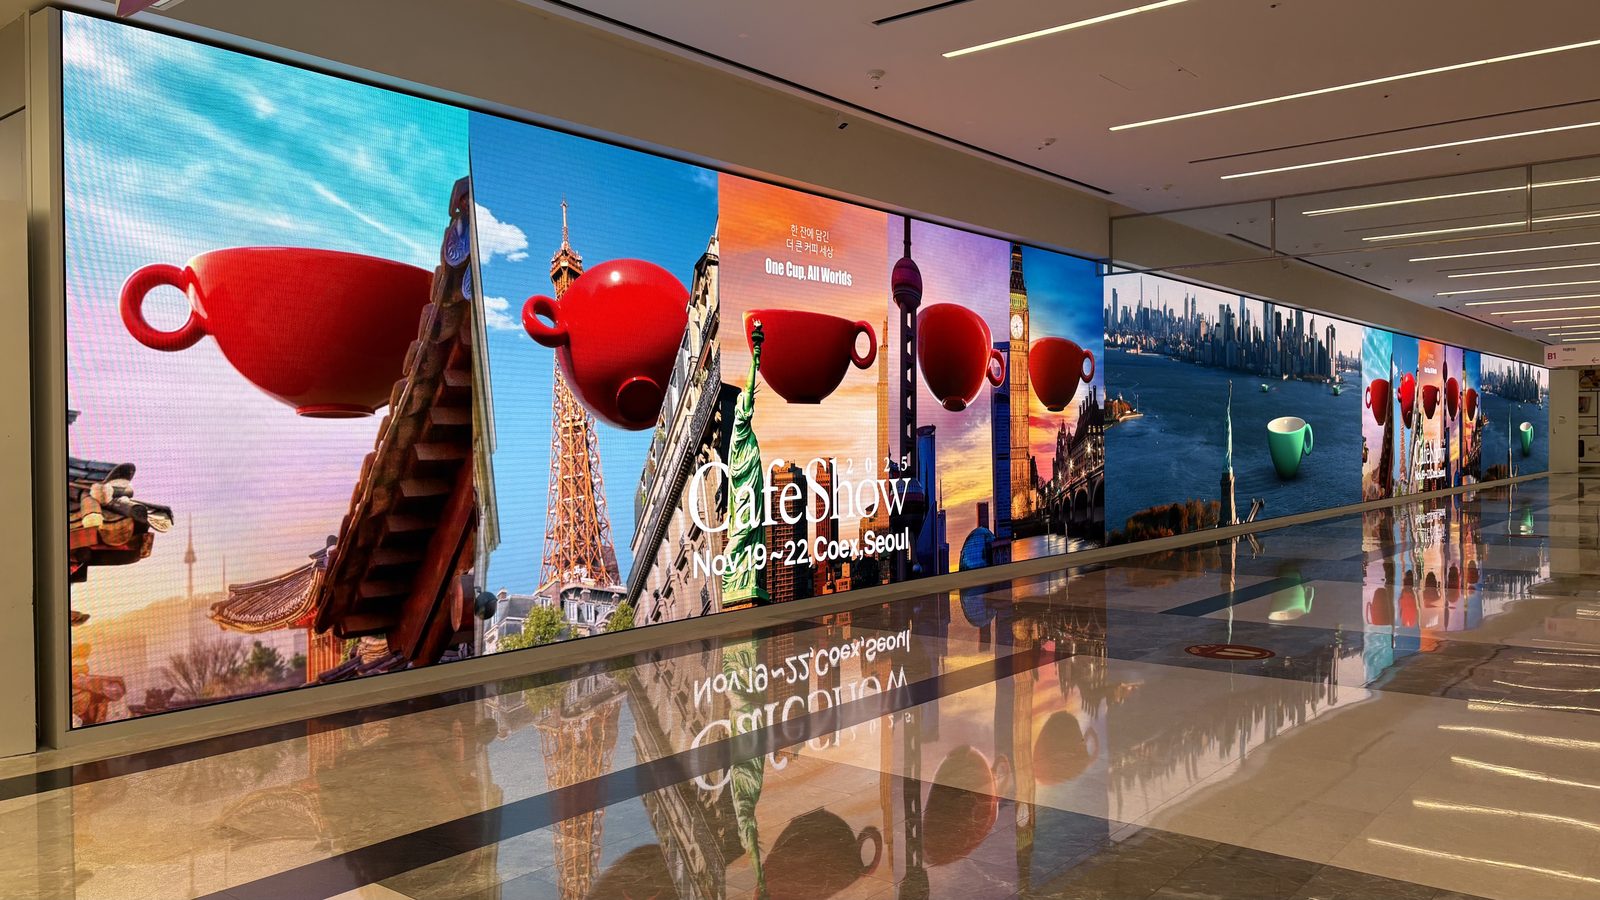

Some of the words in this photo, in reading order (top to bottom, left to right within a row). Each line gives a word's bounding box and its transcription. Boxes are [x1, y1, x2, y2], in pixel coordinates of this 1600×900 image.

[790, 224, 798, 237] 한
[800, 226, 814, 239] 잔에
[815, 229, 829, 243] 담긴
[786, 239, 794, 251] 더
[795, 240, 802, 253] 큰
[804, 241, 818, 255] 커피
[820, 244, 834, 259] 세상
[765, 257, 785, 276] One
[786, 261, 806, 280] Cup,
[807, 265, 819, 281] All
[820, 267, 852, 287] Worlds
[1547, 352, 1557, 360] B1
